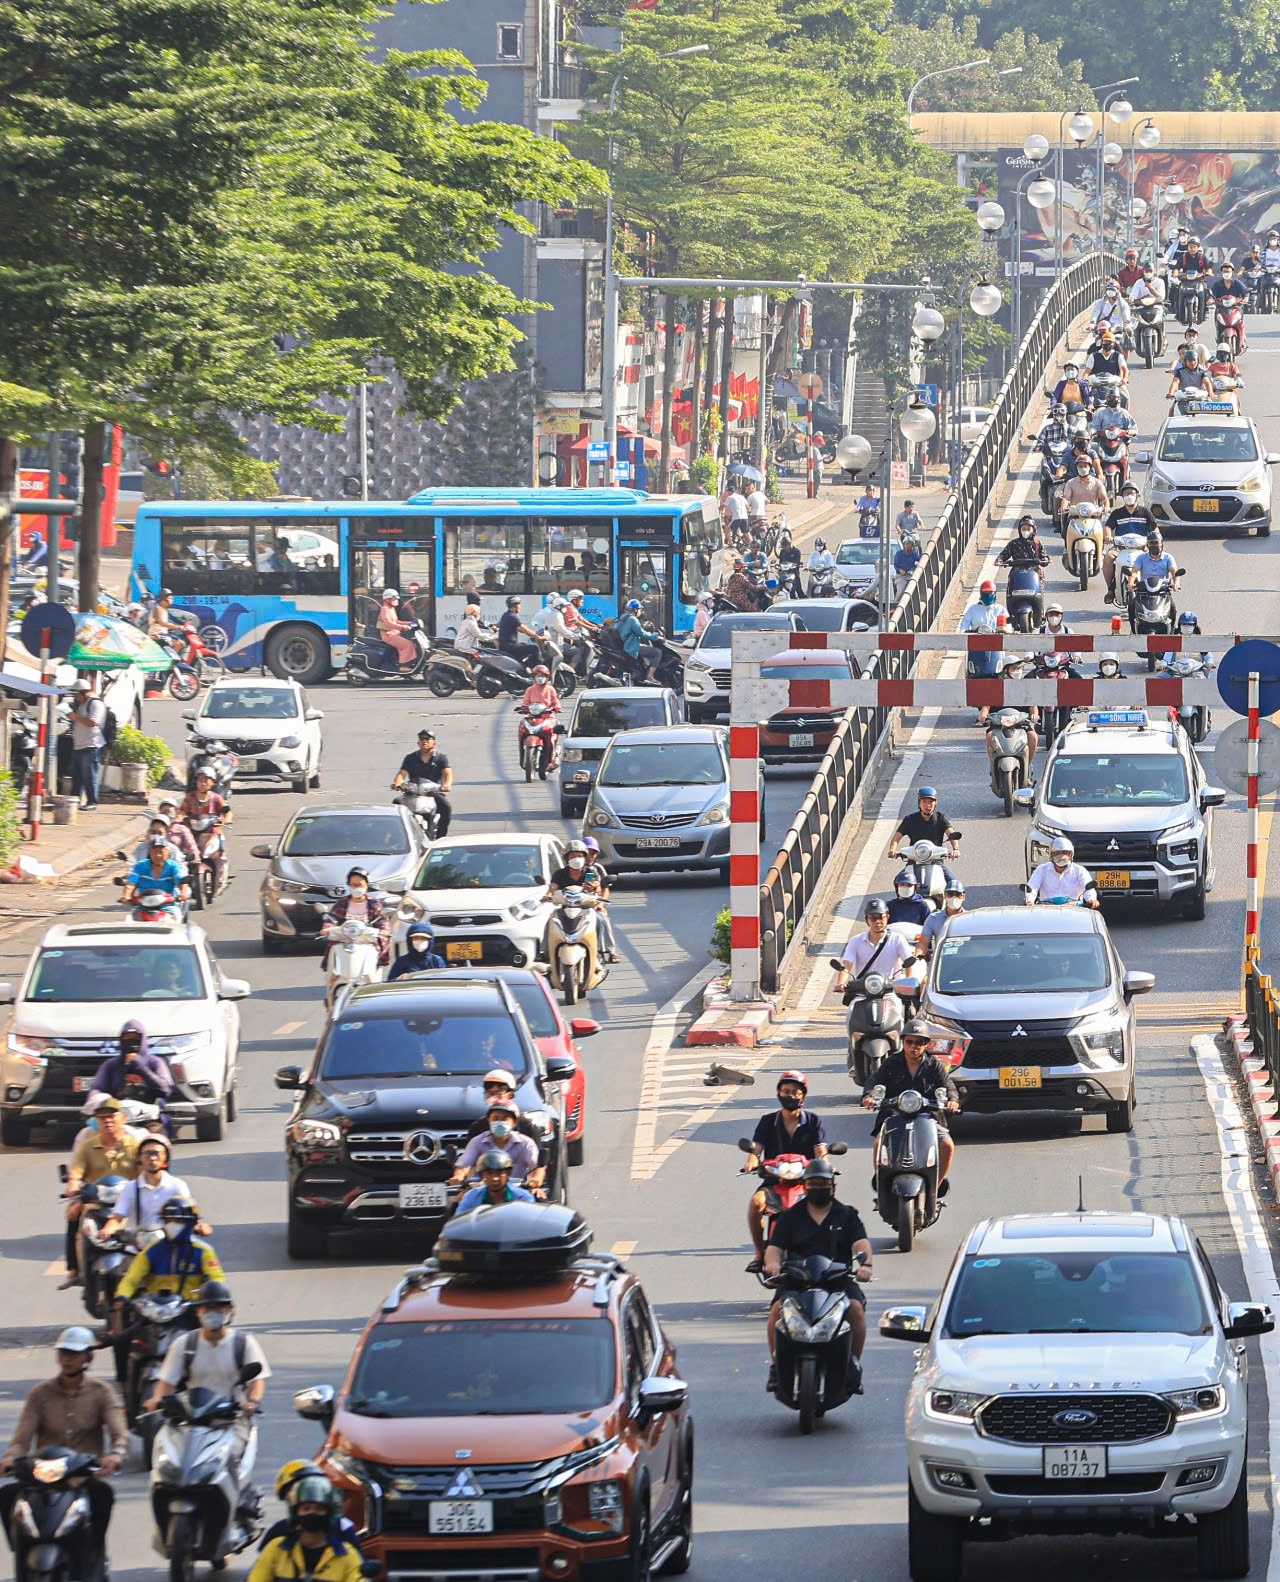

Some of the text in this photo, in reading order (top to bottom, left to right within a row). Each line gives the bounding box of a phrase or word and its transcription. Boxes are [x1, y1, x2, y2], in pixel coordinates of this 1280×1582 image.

[1105, 871, 1121, 879] 29H
[1096, 879, 1127, 888] 898.68
[1010, 1067, 1030, 1077] 29G
[1004, 1077, 1037, 1088] 001.58
[1062, 1411, 1089, 1425] Ford
[1063, 1448, 1088, 1462] 11A
[1051, 1462, 1100, 1478] 087.37
